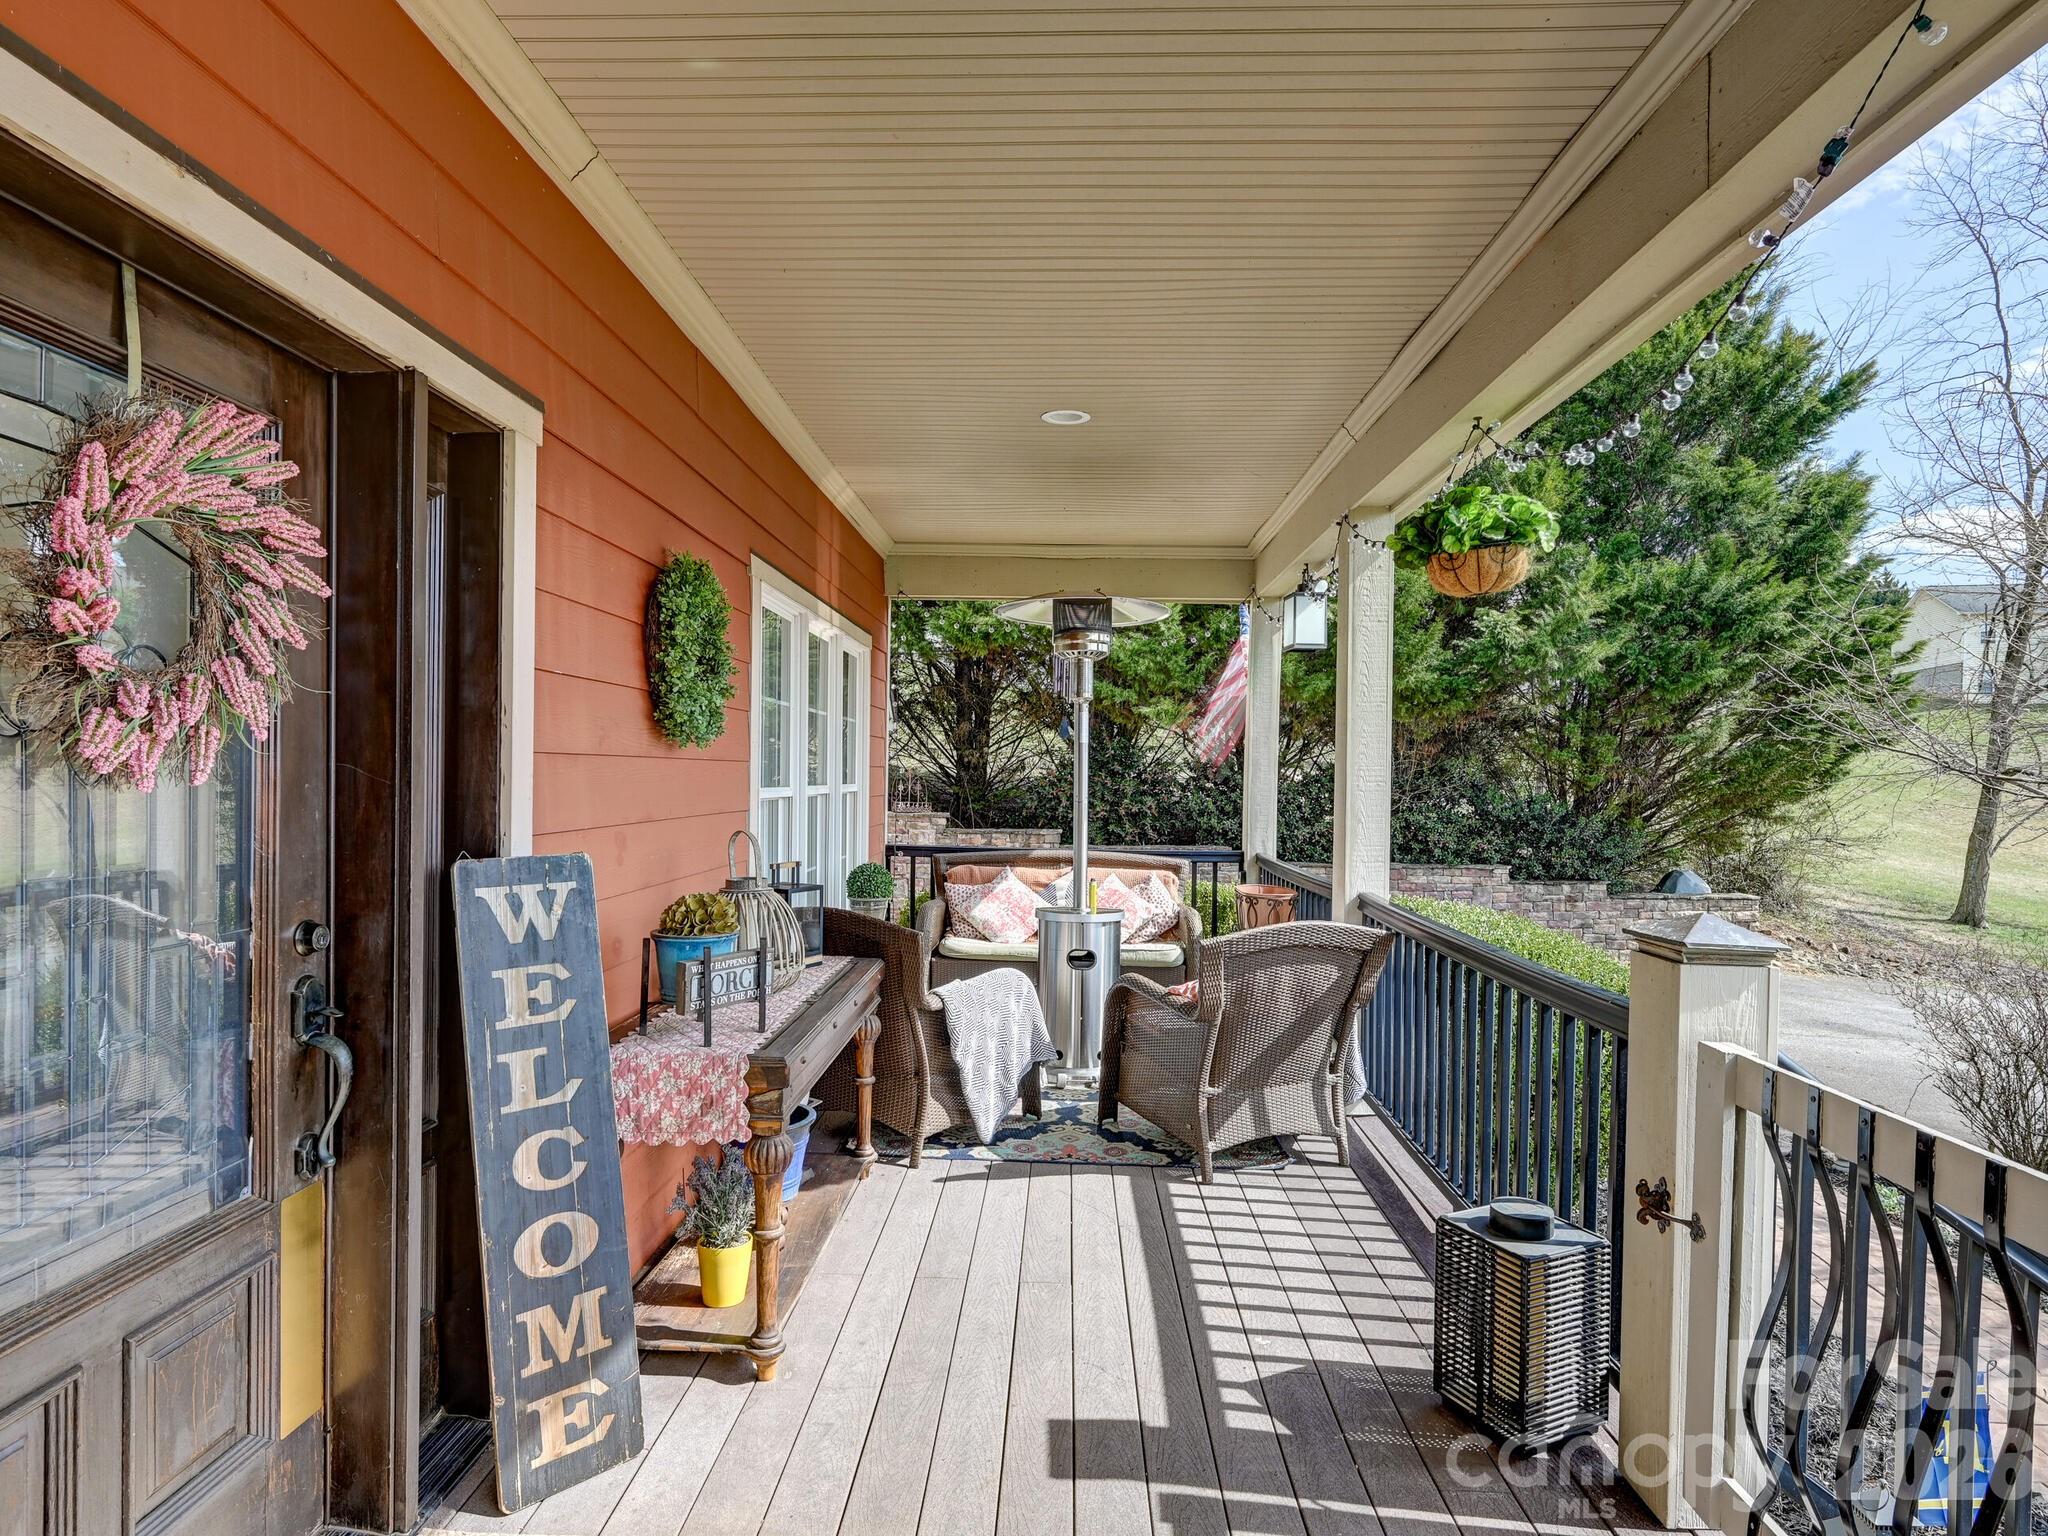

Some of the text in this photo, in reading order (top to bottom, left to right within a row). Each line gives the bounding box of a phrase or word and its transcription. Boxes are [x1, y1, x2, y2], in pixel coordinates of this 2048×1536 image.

[691, 962, 713, 974] WHT
[715, 956, 747, 970] HAPPENS
[747, 955, 758, 964] ON
[690, 985, 772, 1010] STAS ON THE POH
[475, 881, 615, 1470] WELCOME
